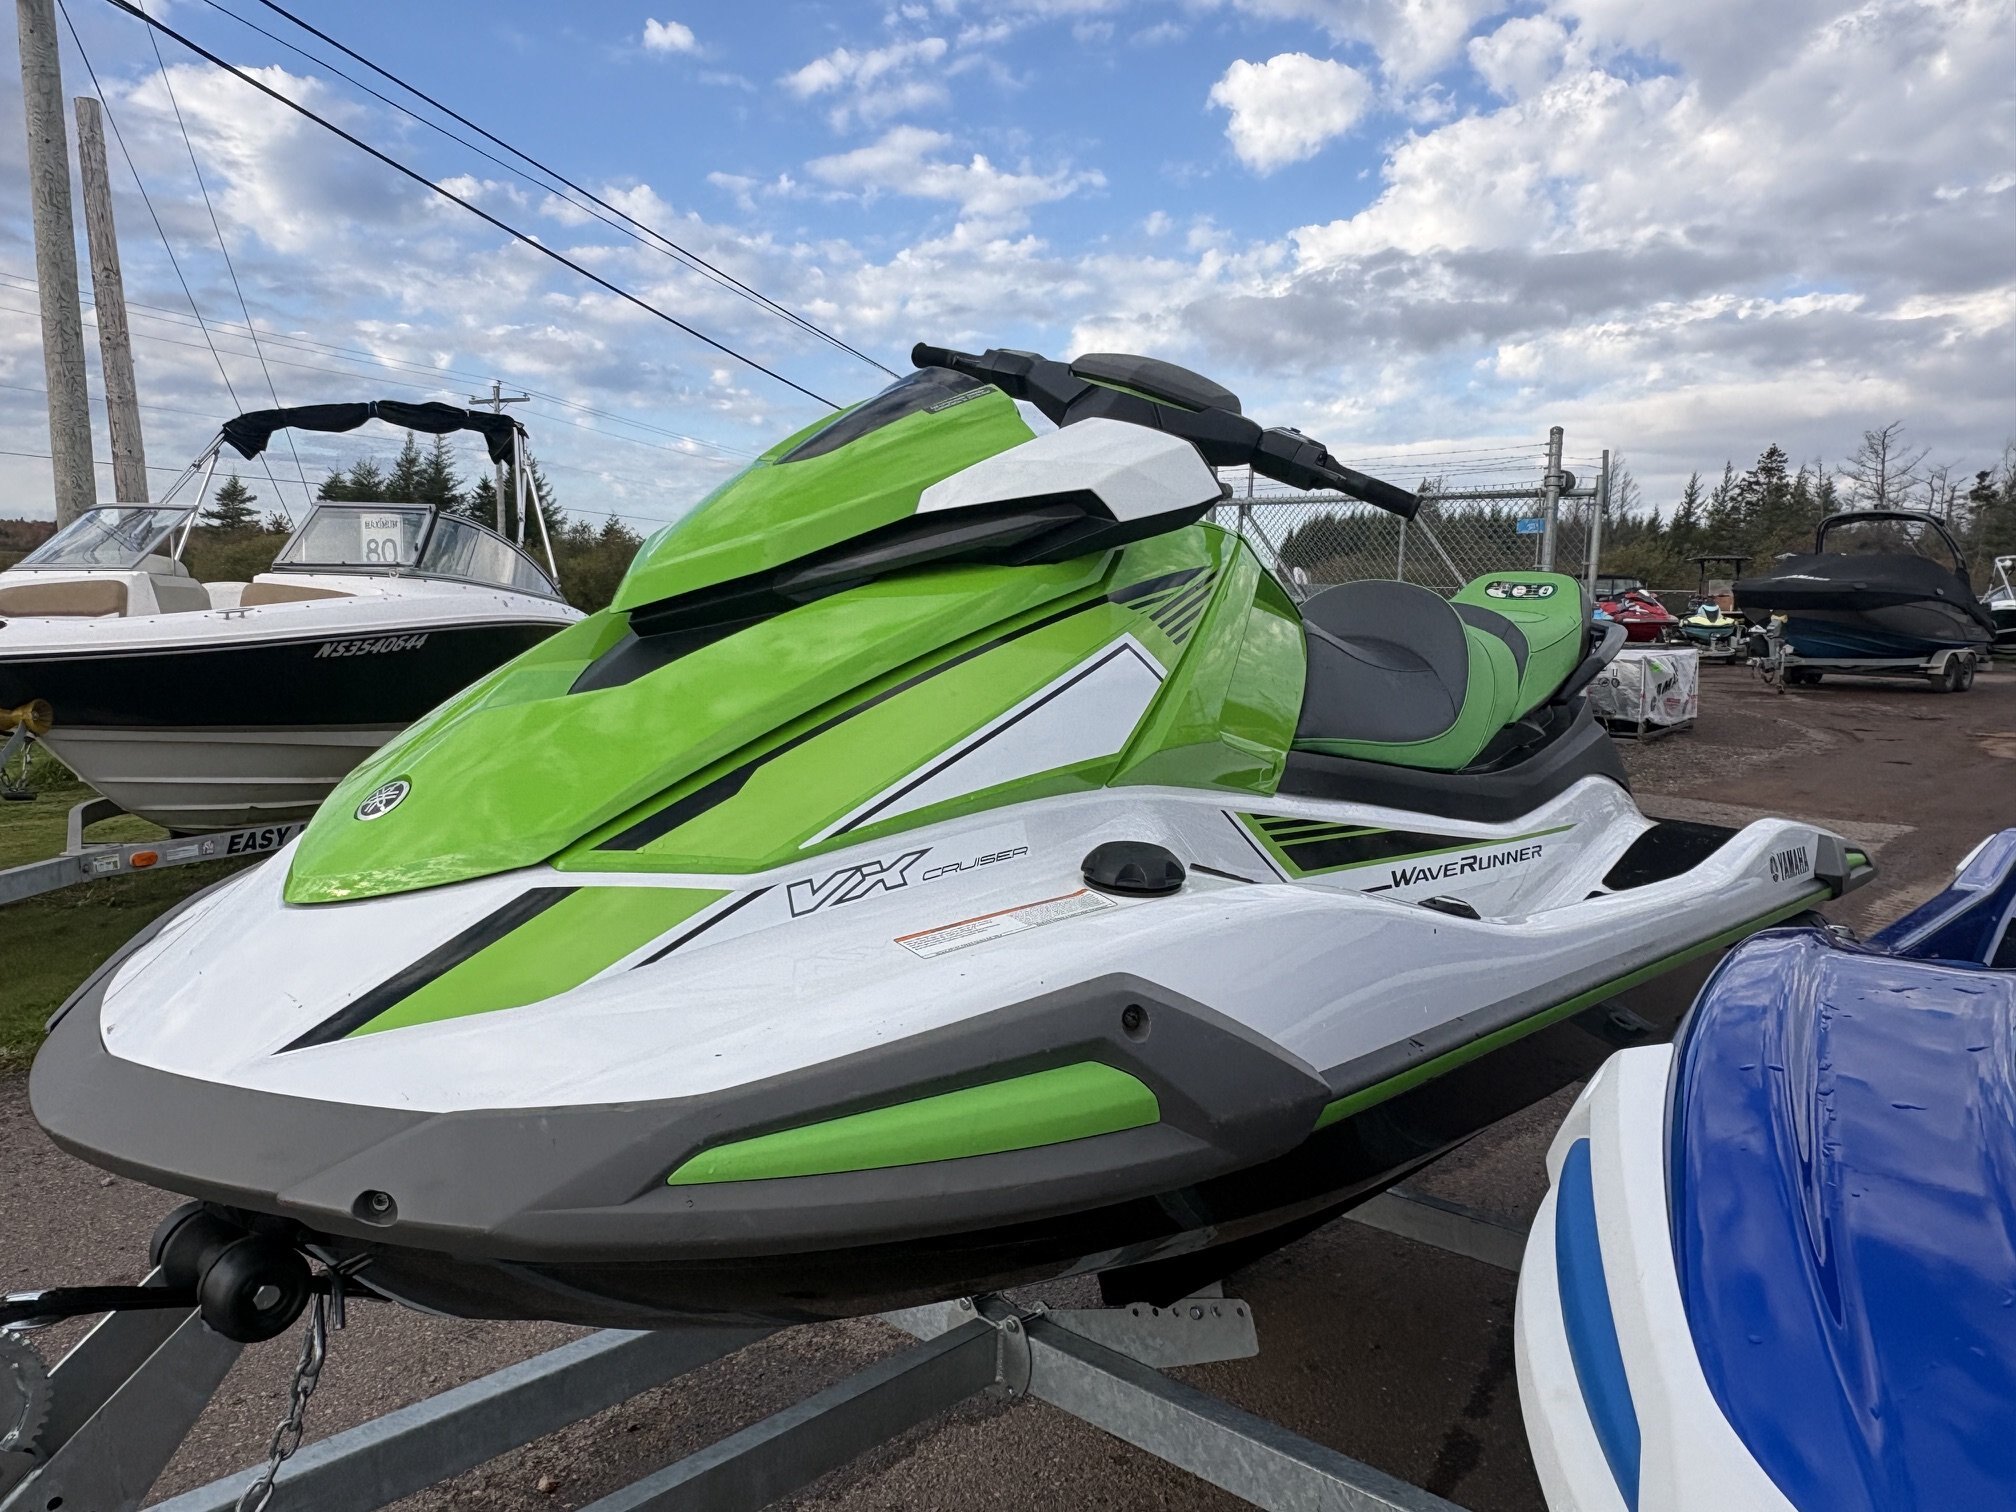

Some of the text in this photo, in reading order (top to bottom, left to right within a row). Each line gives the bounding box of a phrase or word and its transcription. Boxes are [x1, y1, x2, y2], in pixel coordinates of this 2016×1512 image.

[366, 538, 398, 562] 80
[313, 633, 429, 659] NS3540644
[226, 825, 292, 855] EASY
[1776, 845, 1810, 881] YAMAHA
[787, 845, 1029, 918] VX CRUISER
